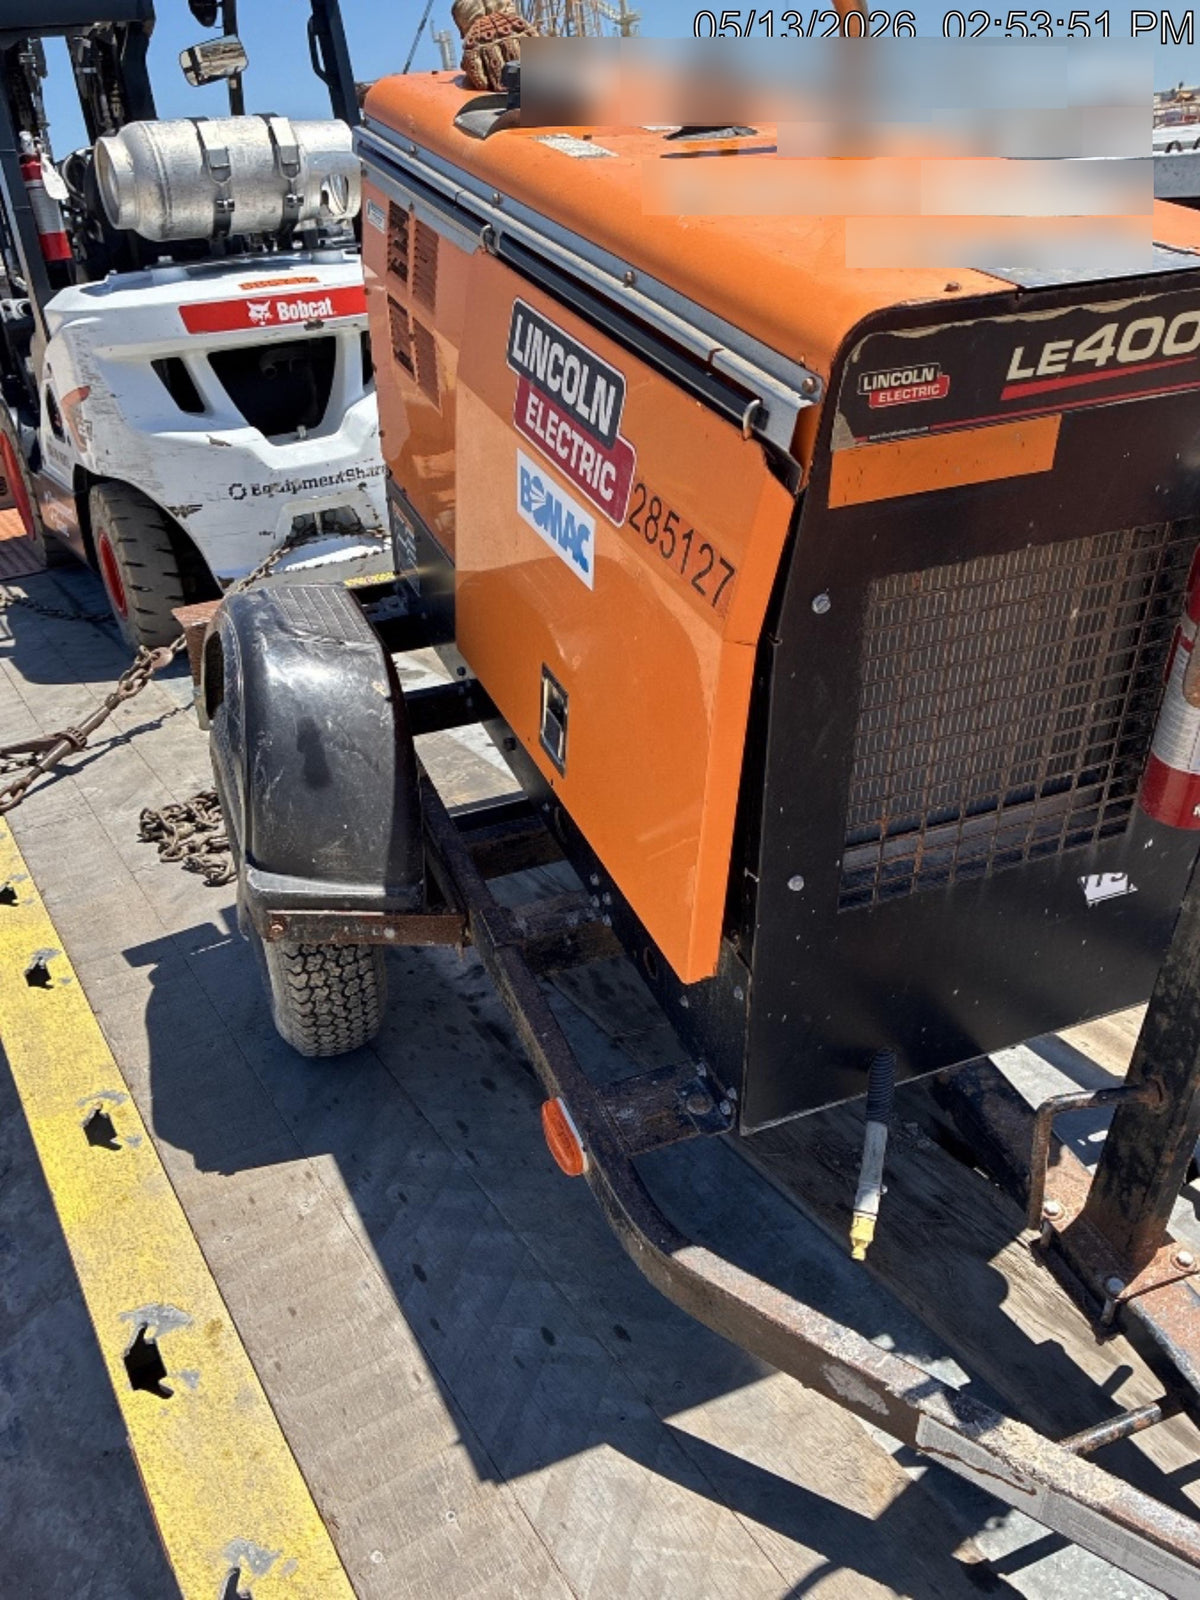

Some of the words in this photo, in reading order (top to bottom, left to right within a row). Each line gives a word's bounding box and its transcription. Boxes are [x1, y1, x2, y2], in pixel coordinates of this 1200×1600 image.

[276, 297, 333, 321] Bobcat
[1006, 311, 1200, 381] LE400
[511, 314, 616, 436] LINCOLN
[863, 367, 936, 391] LINCOLN
[878, 383, 940, 403] ELECTRIC
[525, 391, 616, 502] ELECTRIC
[520, 465, 591, 573] BOMAC
[628, 482, 736, 607] 285127
